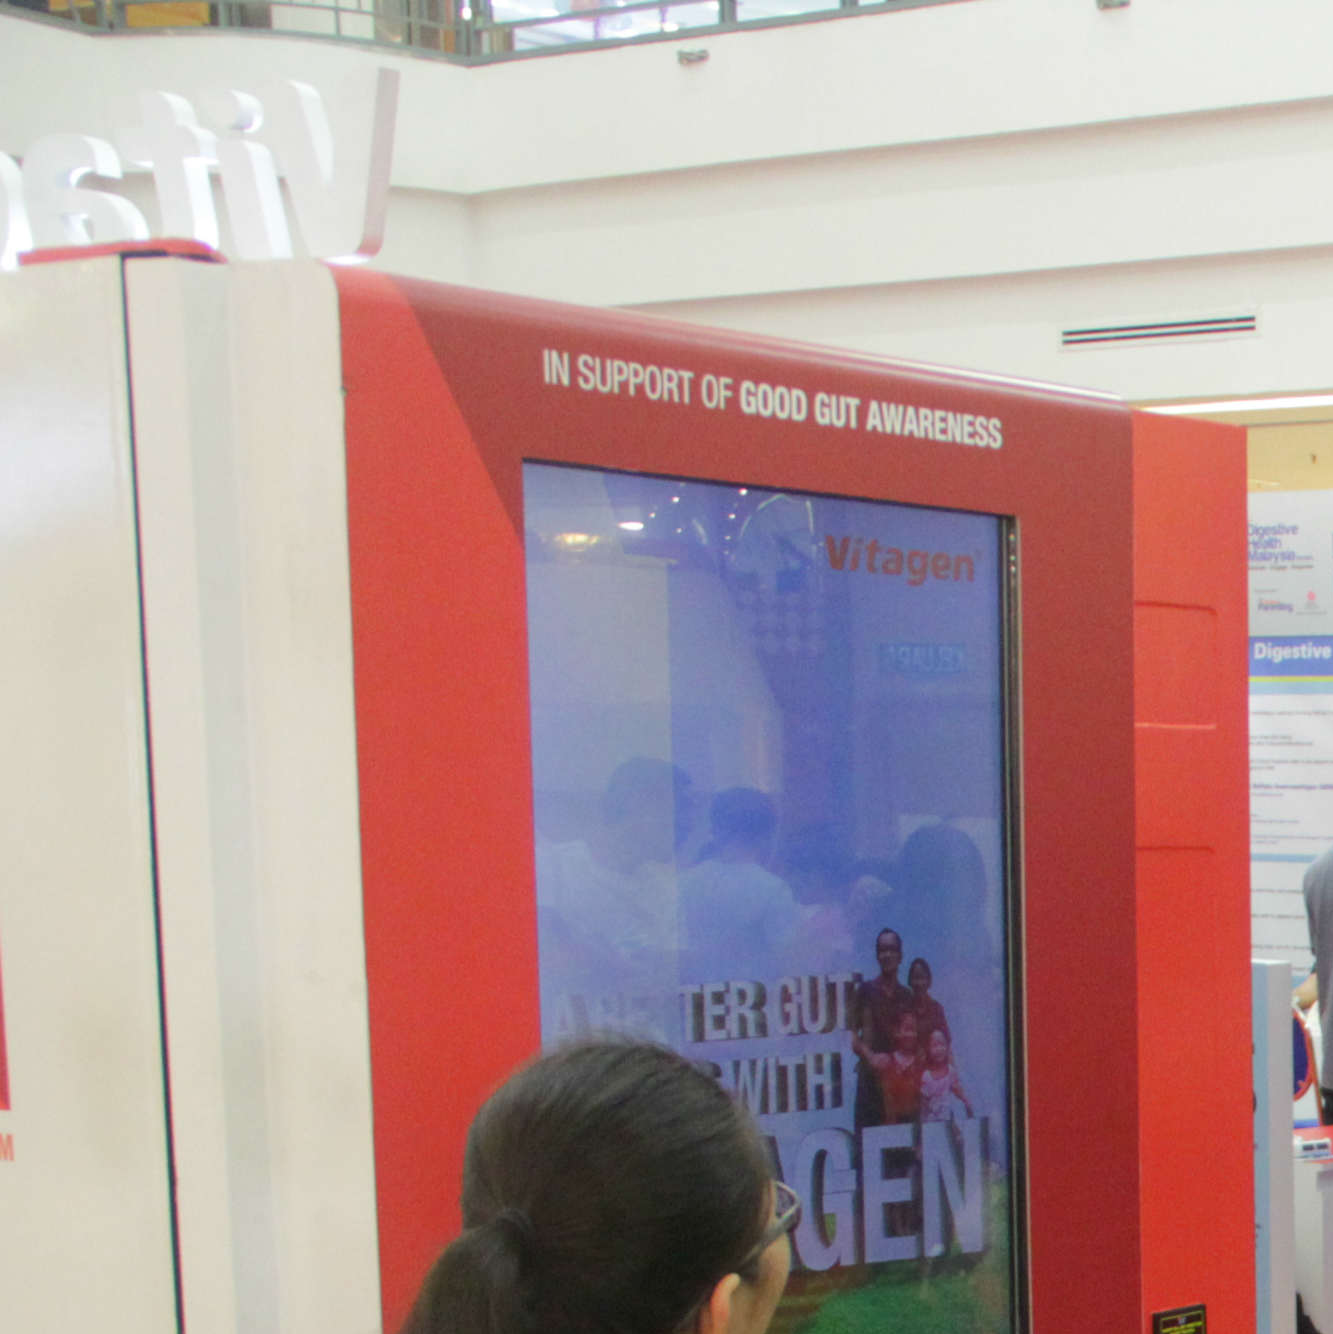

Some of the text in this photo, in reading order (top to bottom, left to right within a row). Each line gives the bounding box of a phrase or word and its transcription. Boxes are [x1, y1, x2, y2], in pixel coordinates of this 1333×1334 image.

[543, 349, 1003, 449] IN SUPPORT OF GOOD GUT AWARENESS
[824, 533, 977, 587] Vitagen
[1254, 641, 1332, 661] Digestive
[769, 973, 859, 1036] GUT
[795, 1115, 989, 1273] GEN
